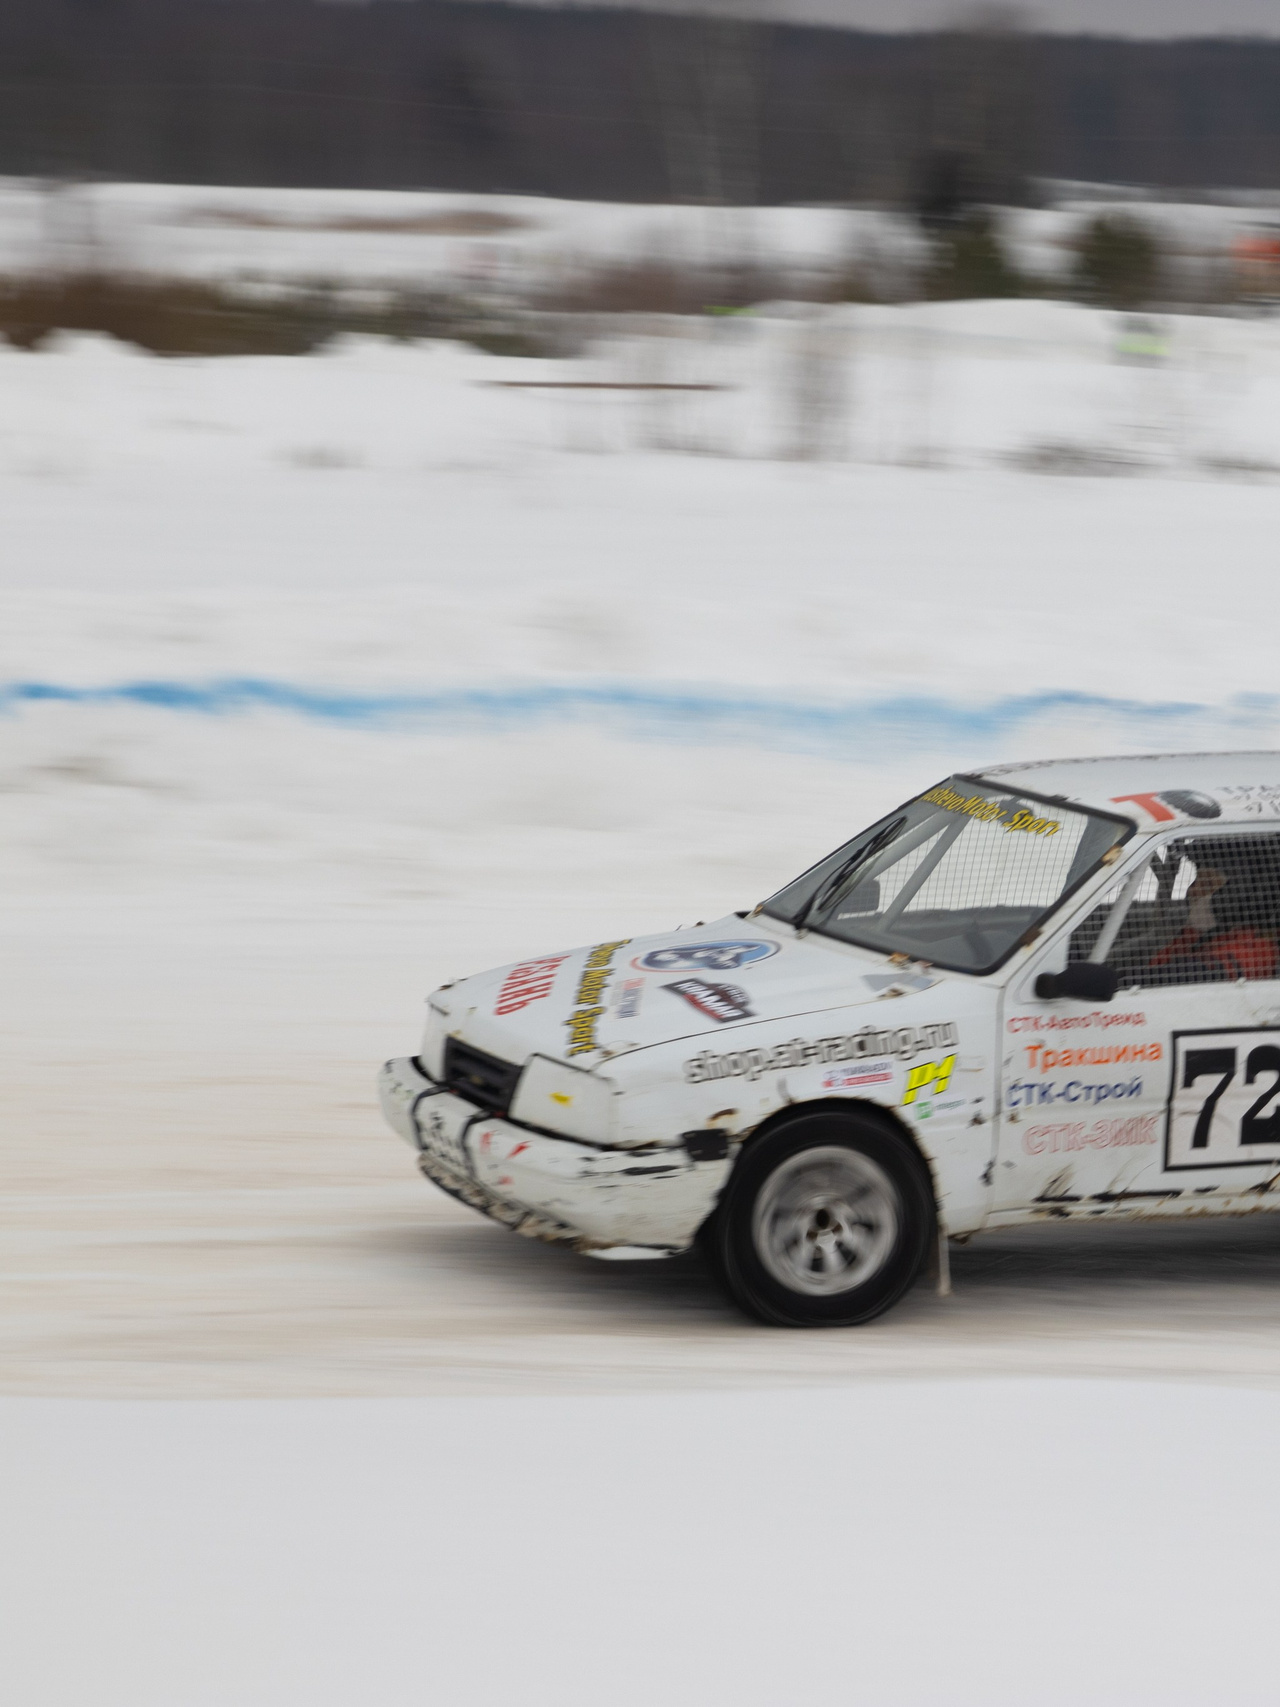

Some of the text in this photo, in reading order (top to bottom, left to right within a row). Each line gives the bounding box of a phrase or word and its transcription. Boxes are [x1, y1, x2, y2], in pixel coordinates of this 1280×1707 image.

[573, 967, 616, 1005] Motor
[563, 1005, 608, 1059] Sport
[1023, 1042, 1164, 1075] Тракшина
[1006, 1074, 1144, 1108] СТК-Строй
